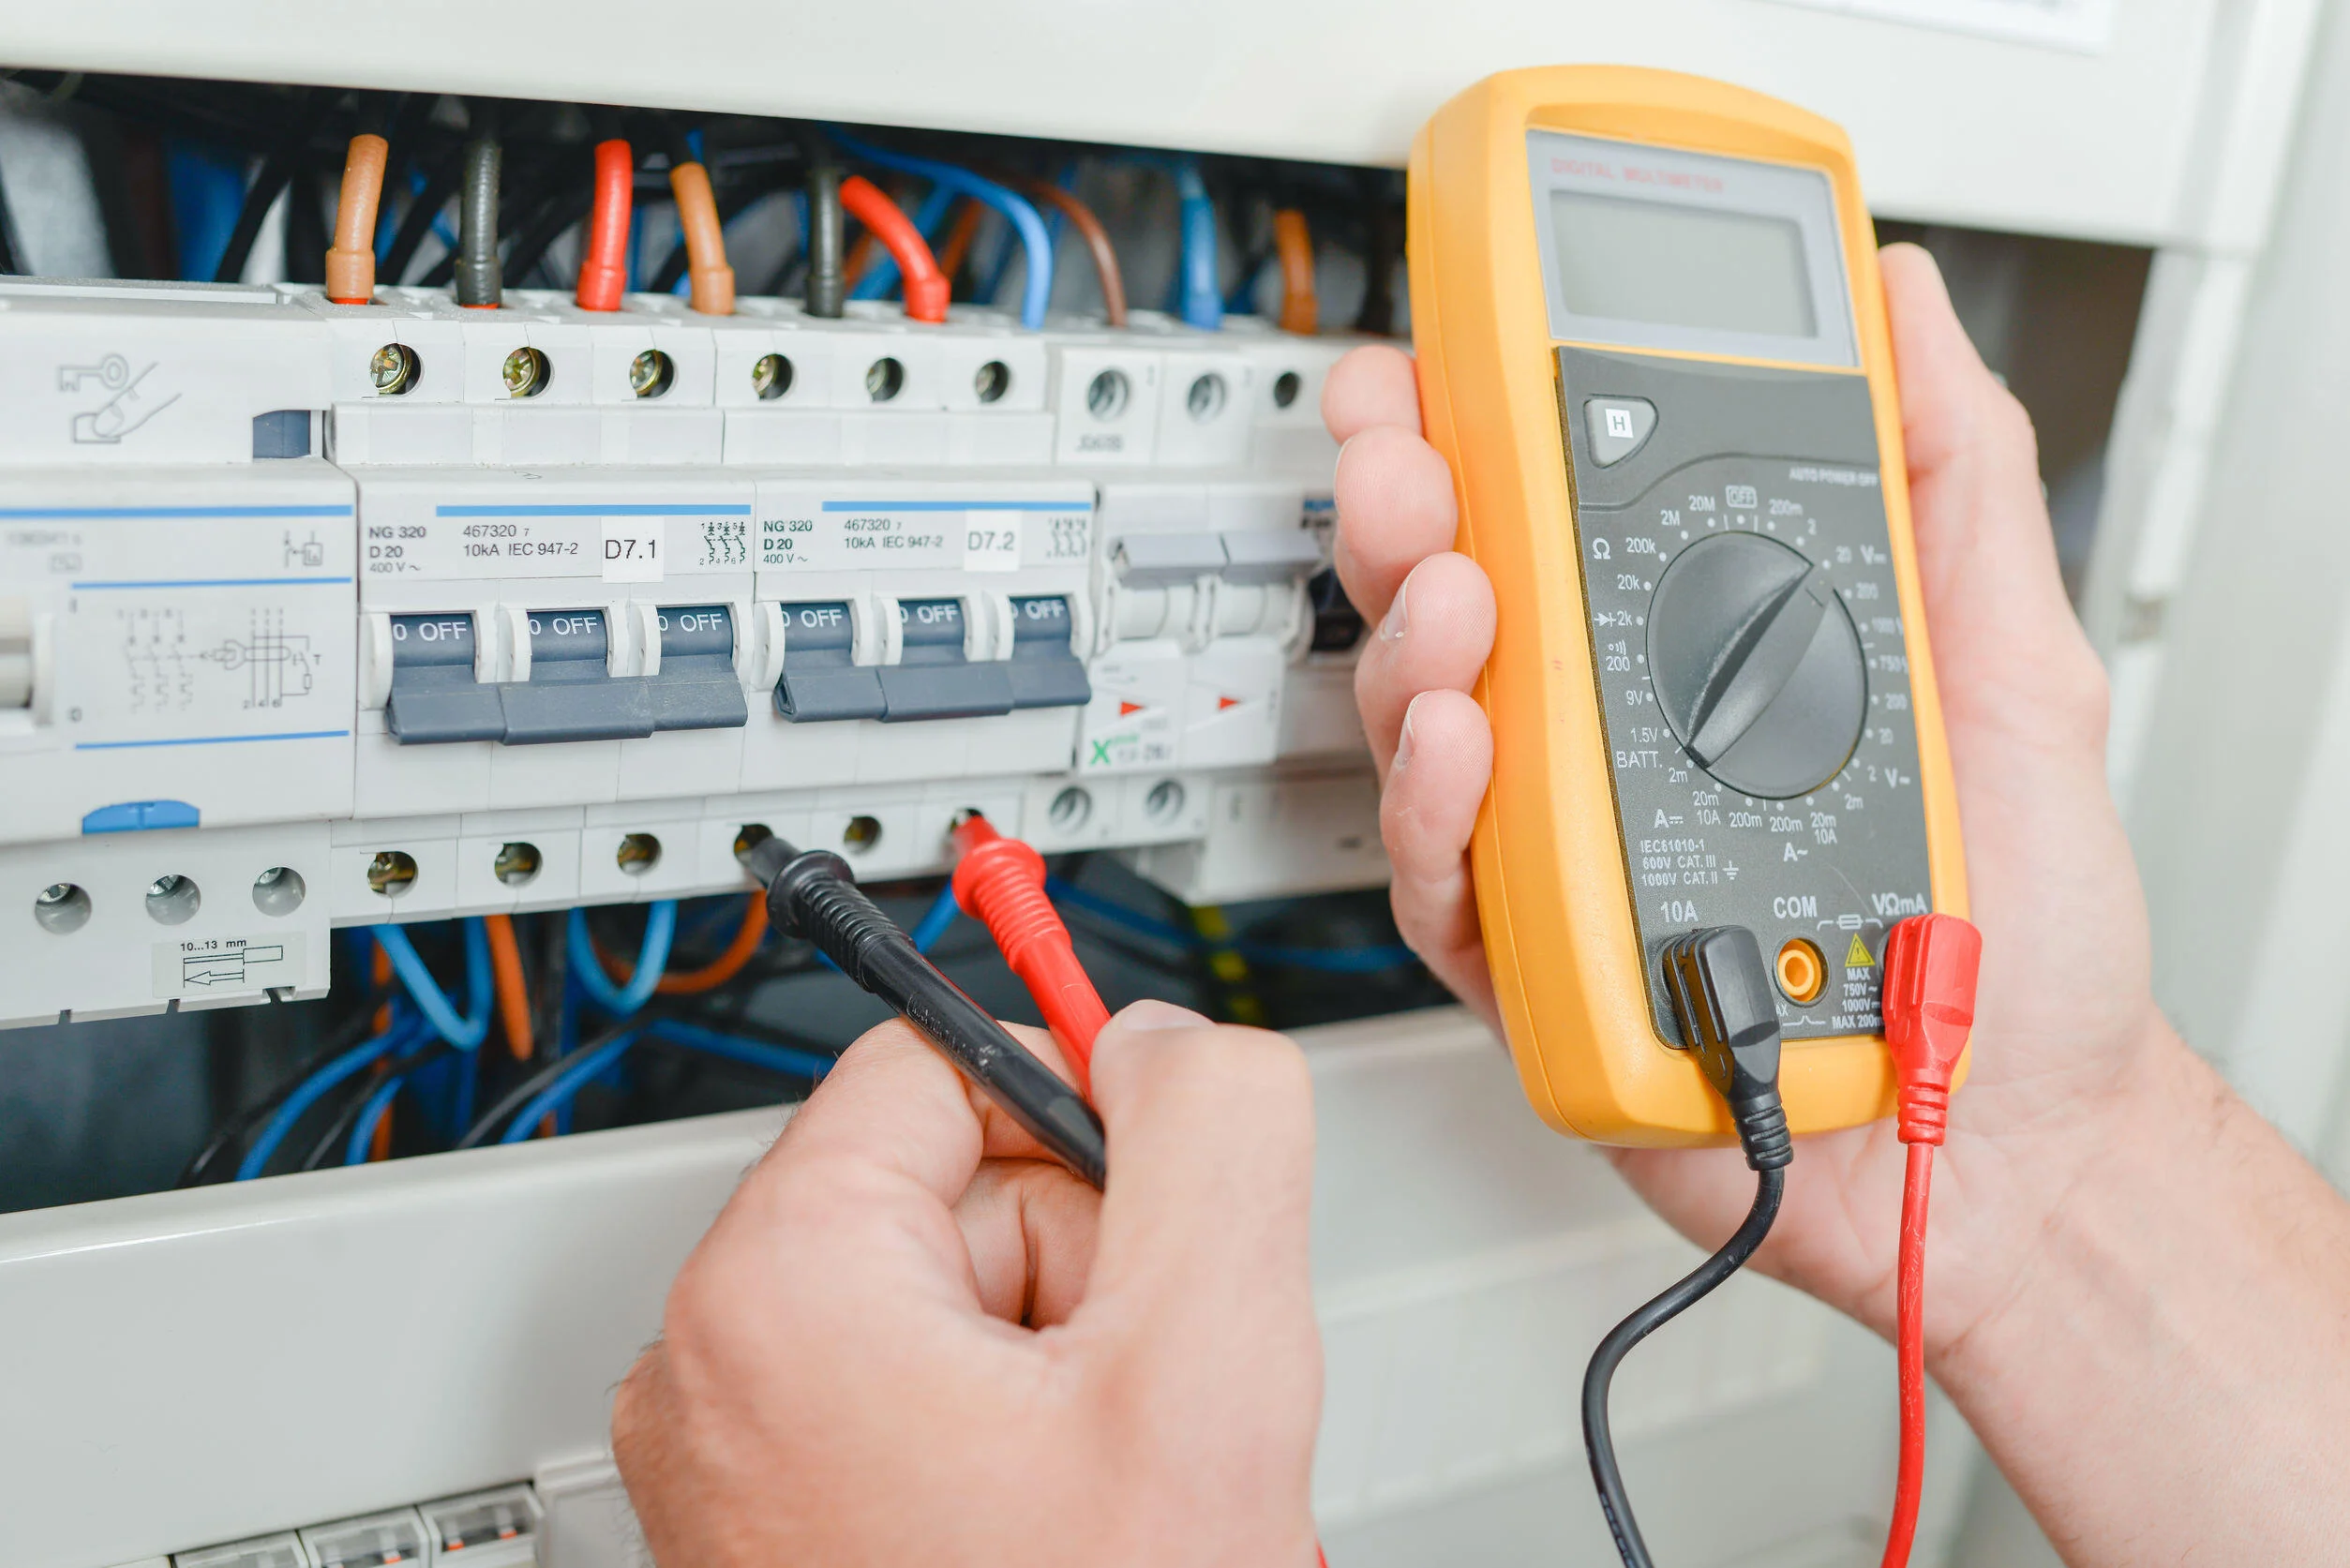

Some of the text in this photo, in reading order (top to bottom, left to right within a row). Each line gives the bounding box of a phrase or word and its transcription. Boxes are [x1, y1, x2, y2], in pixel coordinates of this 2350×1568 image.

[1551, 157, 1726, 194] DIGITAL MULTIMETER
[1612, 415, 1625, 431] H
[1789, 467, 1818, 482] AUTO
[1819, 468, 1856, 485] POWER
[1688, 495, 1715, 512] 20M
[1729, 489, 1753, 504] OFF
[763, 520, 813, 532] NG 320
[845, 518, 891, 531] 467320
[1660, 510, 1680, 526] 2M
[1807, 517, 1817, 535] 2
[368, 526, 427, 538] NG 320
[463, 524, 516, 538] 467320
[763, 538, 793, 550] D 20
[845, 535, 943, 549] 10kA IEC 947-2
[967, 530, 1014, 551] D7.2
[1625, 537, 1656, 554] 200k
[369, 545, 403, 558] D 20
[463, 542, 578, 557] 10kA IEC 947-2
[605, 539, 656, 560] D7.1
[1835, 545, 1851, 563] 20
[763, 554, 794, 564] 400 V
[369, 562, 406, 573] 400 V
[1617, 574, 1640, 590] 20k
[917, 604, 958, 624] OFF
[1025, 599, 1065, 620] OFF
[529, 617, 597, 635] 0 OFF
[680, 613, 723, 633] OFF
[801, 608, 843, 628] OFF
[1617, 610, 1632, 626] 2k
[392, 621, 467, 641] 0 OFF
[1605, 656, 1630, 672] 200
[1626, 690, 1643, 706] 9V
[1631, 727, 1657, 743] 1.5V
[1616, 751, 1663, 769] BATT.
[1669, 767, 1688, 784] 2m
[1867, 764, 1877, 782] 2
[1692, 790, 1719, 807] 20m
[1845, 793, 1864, 811] 2m
[1697, 809, 1721, 826] 10A
[1729, 812, 1762, 829] 200m
[1770, 816, 1803, 832] 200m
[1810, 812, 1837, 828] 20m
[1814, 829, 1837, 844] 10A
[1640, 839, 1705, 853] IEC61010-1
[1642, 854, 1716, 870] 600V CAT. III
[1641, 871, 1718, 887] 1000V CAT. II
[1660, 900, 1699, 923] 10A
[1774, 895, 1819, 918] COM
[1871, 892, 1928, 916] VΩmA
[180, 938, 247, 952] 10...13 mm
[1846, 967, 1871, 981] MAX
[1843, 982, 1867, 997] 750V
[1841, 997, 1872, 1012] 1000V
[1831, 1015, 1856, 1029] MAX
